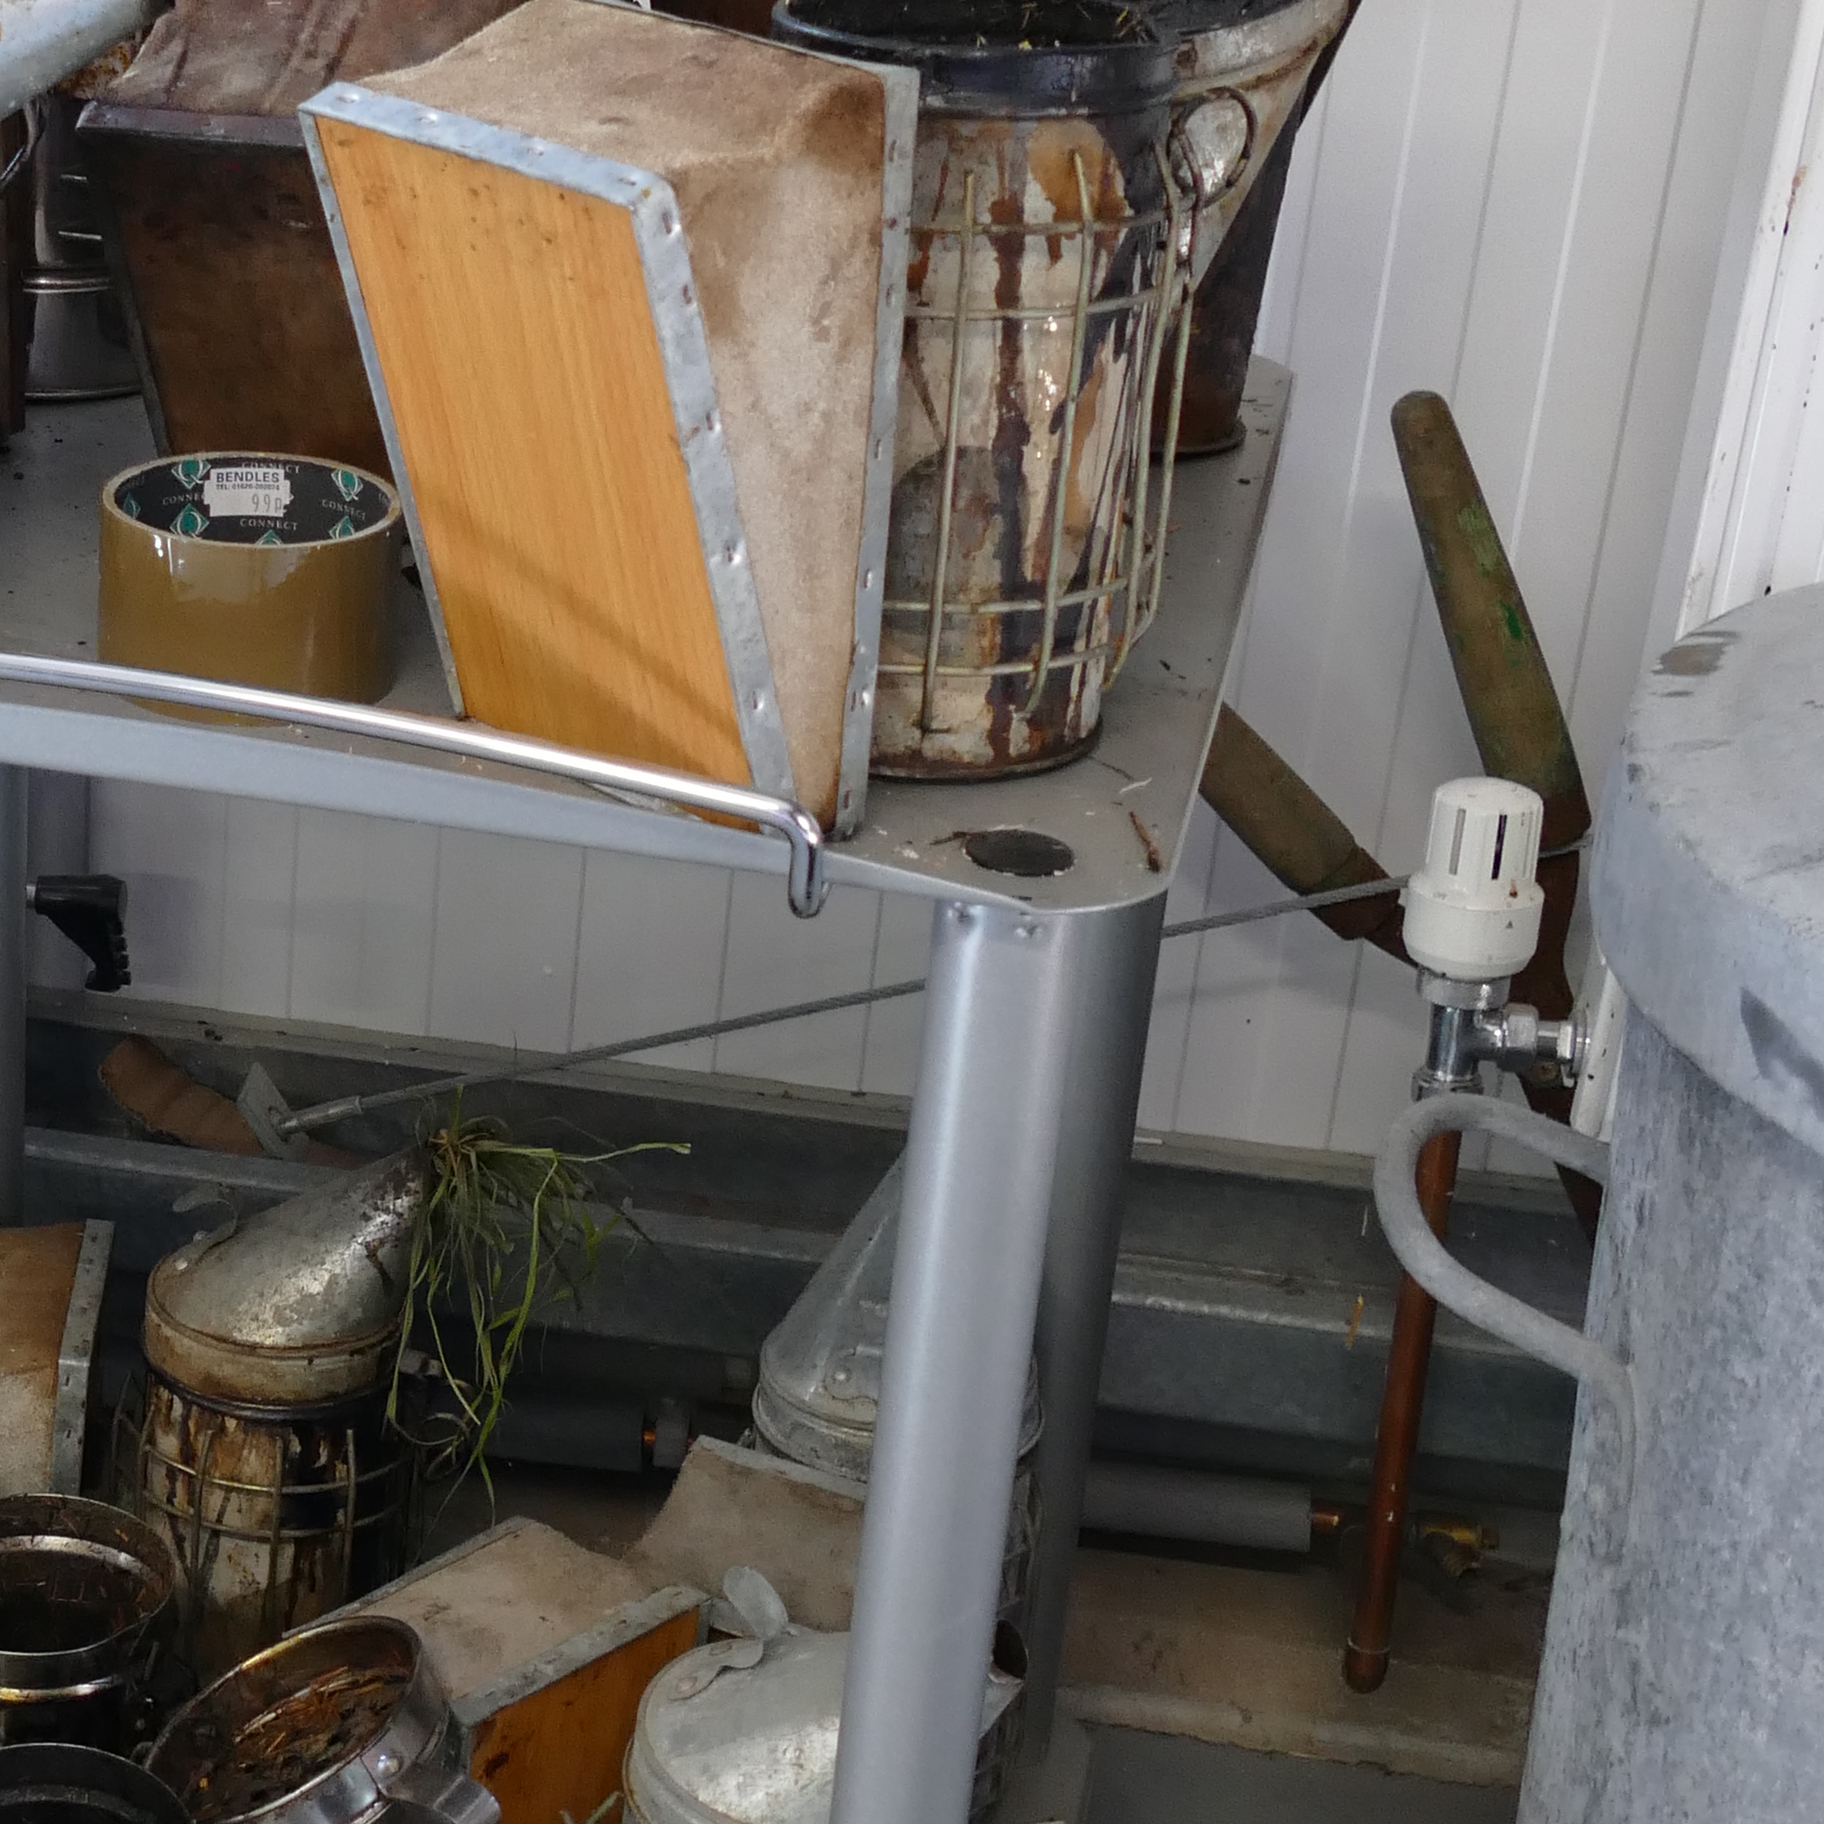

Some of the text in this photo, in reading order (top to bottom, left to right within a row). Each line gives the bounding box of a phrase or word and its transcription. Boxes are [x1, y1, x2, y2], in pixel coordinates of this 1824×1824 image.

[216, 471, 280, 483] BENDLES
[162, 491, 205, 506] CONNE
[321, 498, 367, 521] CONNECT
[239, 518, 299, 532] CONNECT
